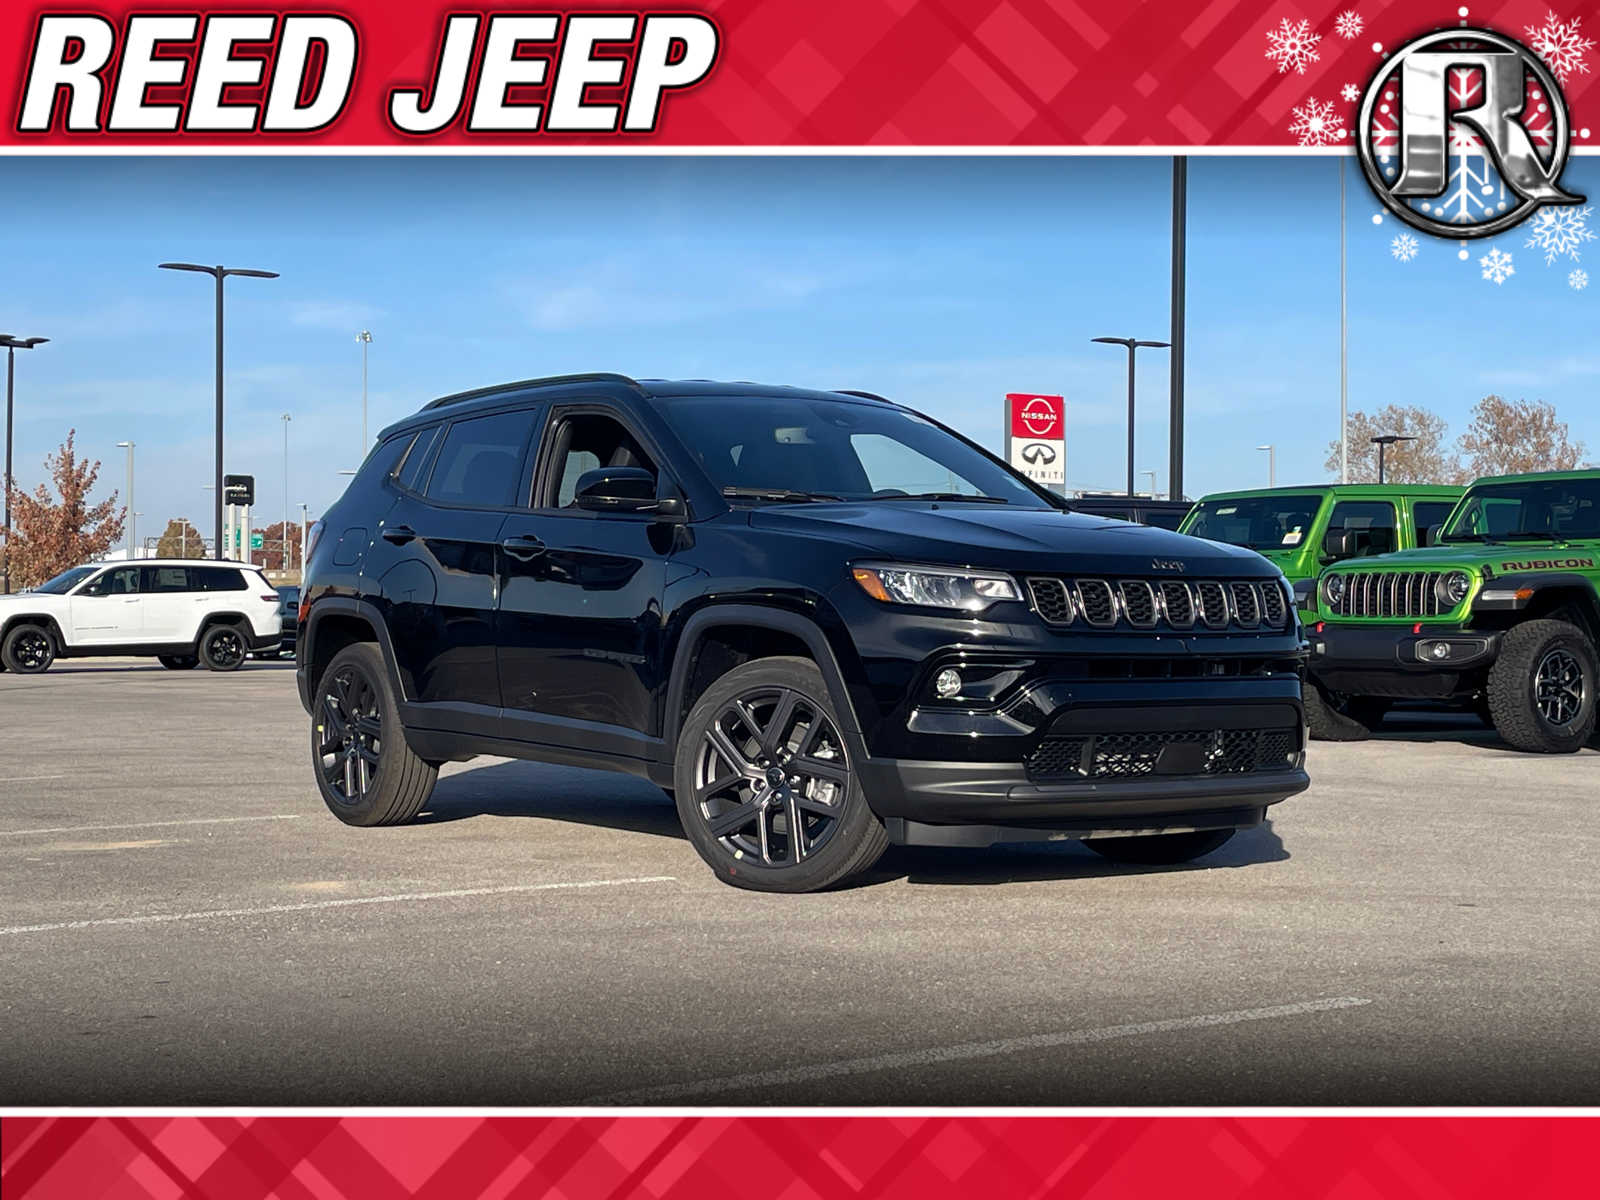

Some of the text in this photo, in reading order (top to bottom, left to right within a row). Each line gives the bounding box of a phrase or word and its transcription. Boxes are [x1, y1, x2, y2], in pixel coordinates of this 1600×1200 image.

[1021, 412, 1057, 420] NISSAN
[1020, 470, 1063, 479] FINITI
[1151, 558, 1185, 573] Jeep
[1501, 559, 1594, 571] RUBICON
